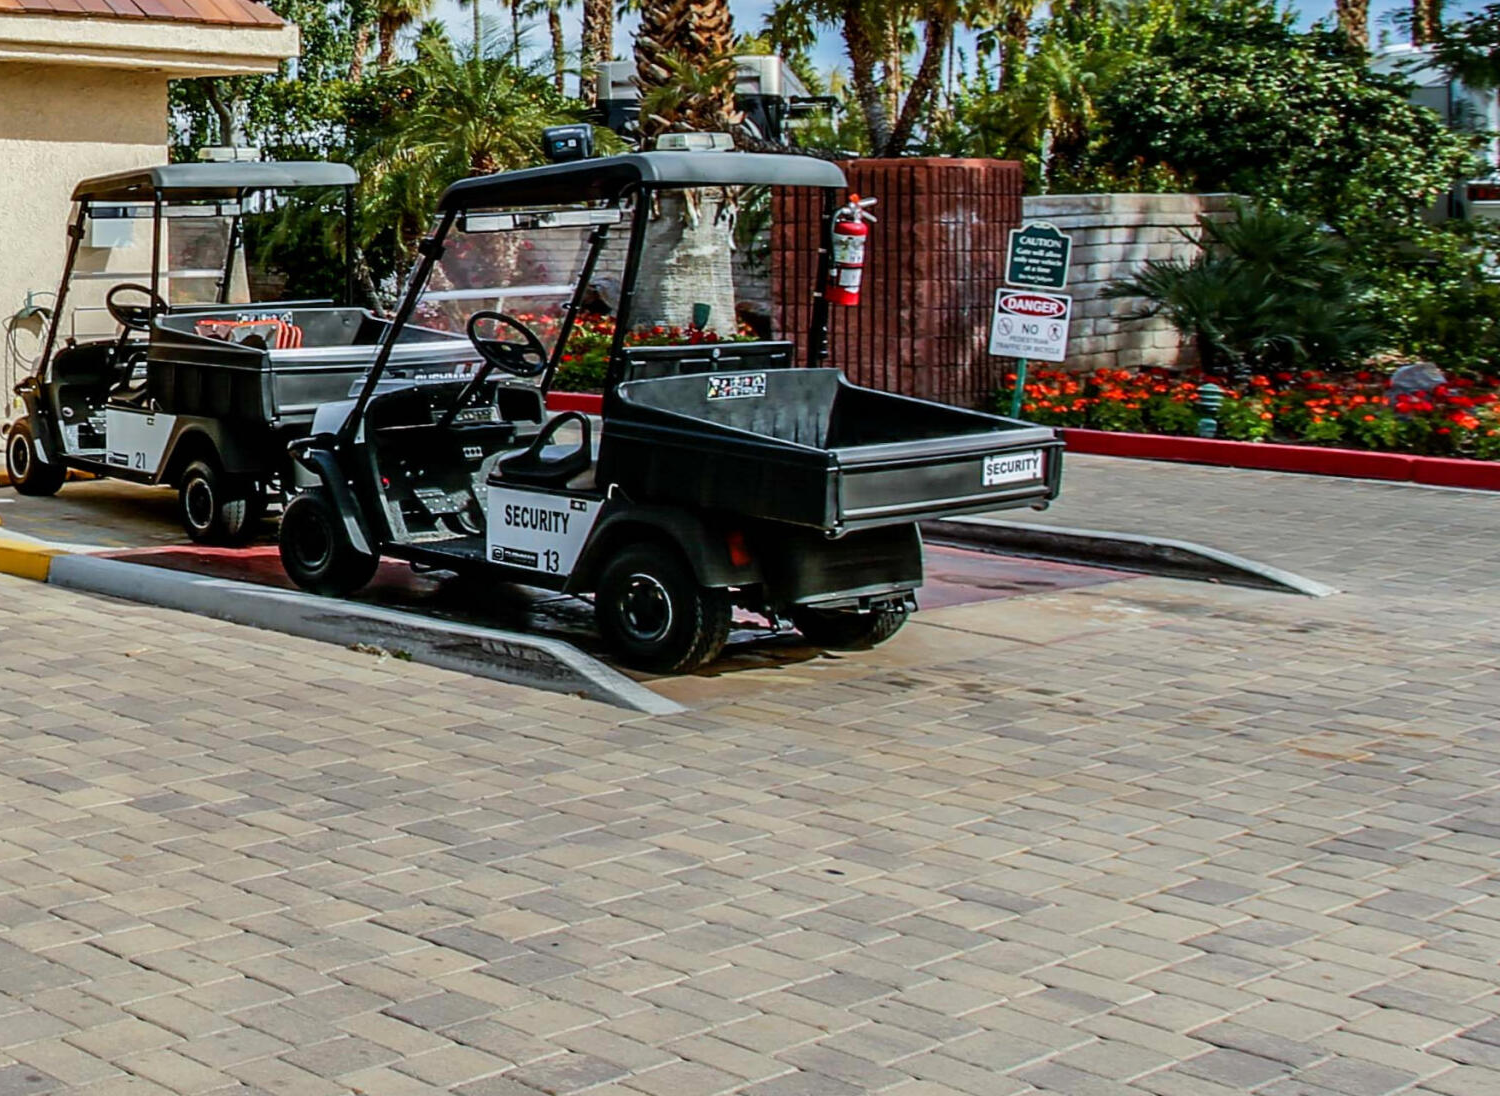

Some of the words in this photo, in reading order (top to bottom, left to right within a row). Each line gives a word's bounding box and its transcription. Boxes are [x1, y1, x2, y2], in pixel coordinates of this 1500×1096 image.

[1019, 235, 1062, 248] CAUTION
[1008, 298, 1058, 314] DANGER
[1022, 324, 1039, 335] NO
[135, 451, 146, 470] 21
[986, 457, 1039, 476] SECURITY
[504, 504, 570, 535] SECURITY
[543, 549, 560, 573] 13
